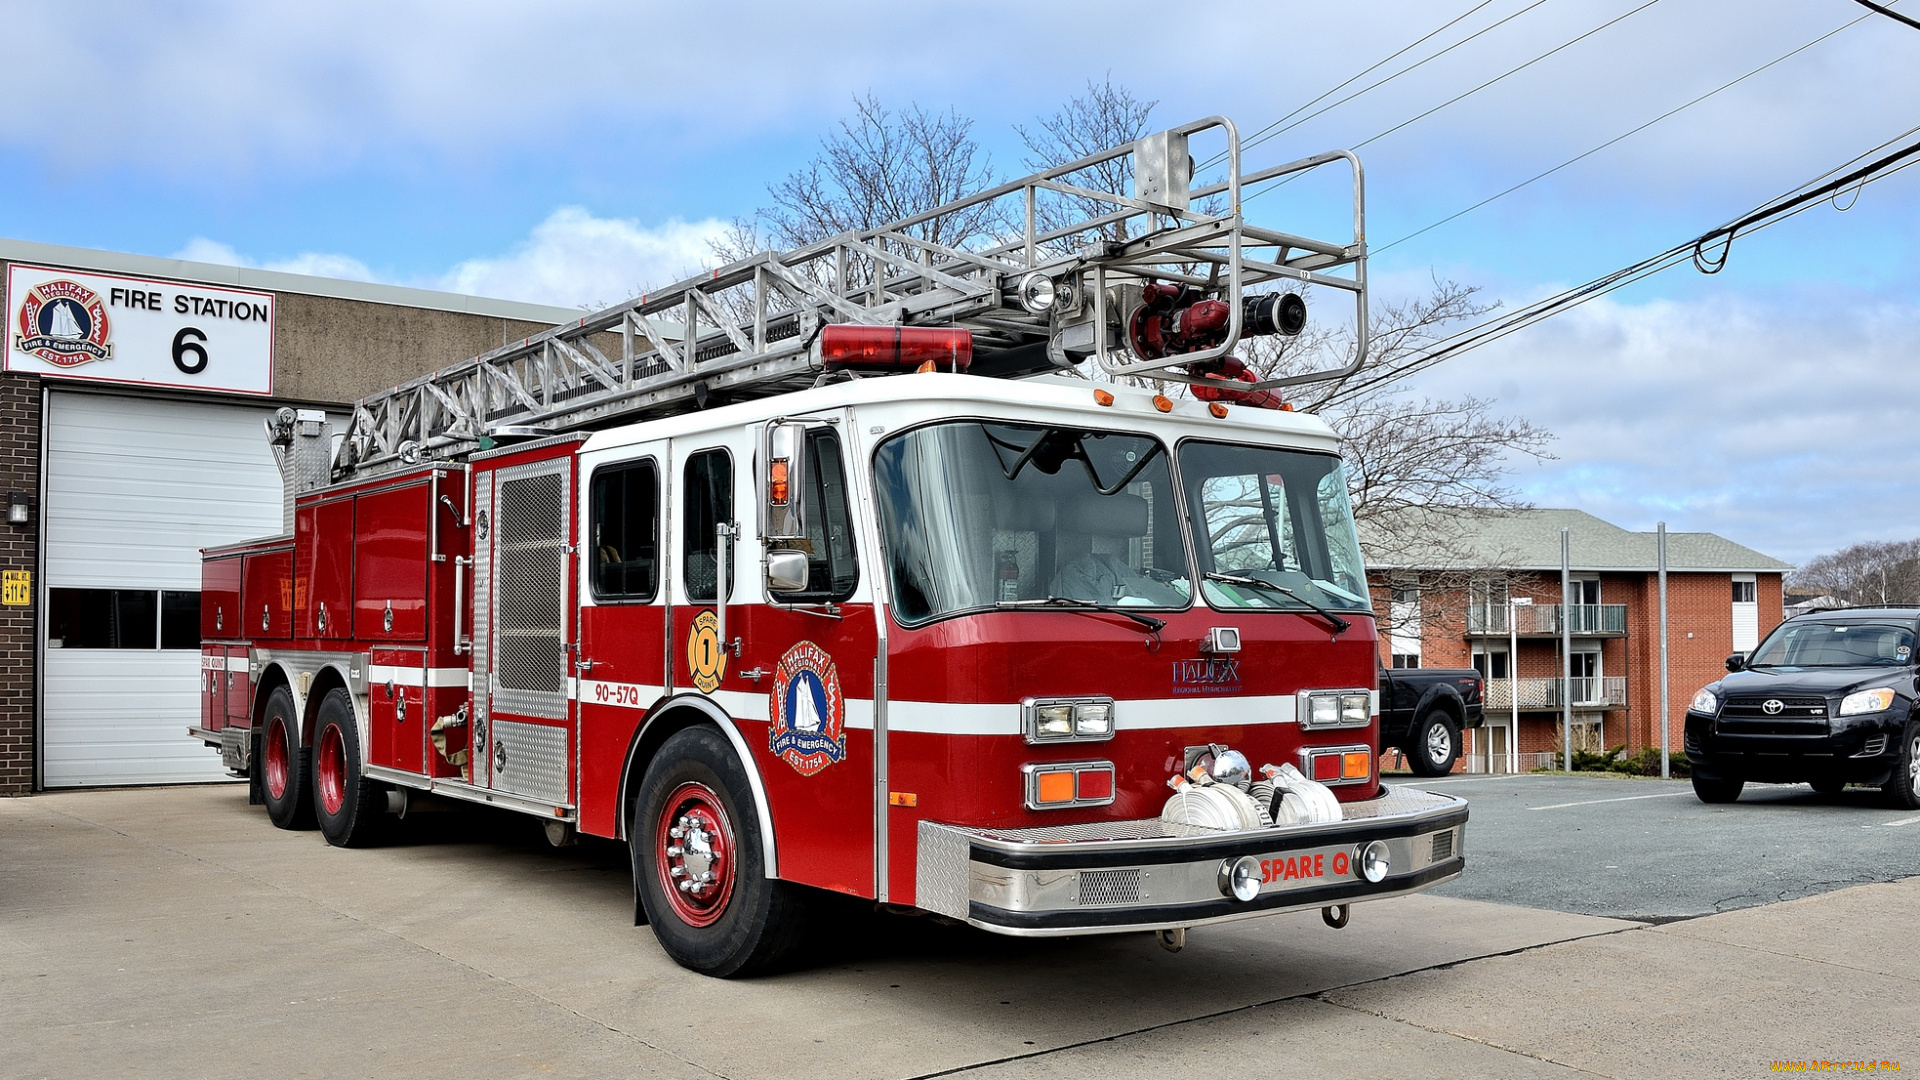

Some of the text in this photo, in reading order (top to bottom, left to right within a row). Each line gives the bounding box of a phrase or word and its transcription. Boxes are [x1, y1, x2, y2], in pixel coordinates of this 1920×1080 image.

[41, 283, 91, 299] HALIFAX
[45, 290, 84, 303] REGIONAL
[110, 287, 268, 322] FIRE STATION
[23, 339, 43, 350] FIRE
[52, 341, 103, 356] EMERGENCY
[41, 350, 85, 363] EST.1754
[171, 327, 208, 374] 6
[699, 615, 717, 627] SPARE
[703, 638, 709, 665] 1
[787, 646, 825, 668] HALIFAX
[790, 659, 821, 674] REGIONAL
[1171, 659, 1241, 683] HALIFAX
[698, 677, 715, 689] QUINT
[595, 683, 638, 705] 90-57Q
[776, 735, 838, 755] FIRE & EMERGENCY
[789, 751, 823, 769] EST.1754
[1260, 851, 1349, 884] SPARE Q
